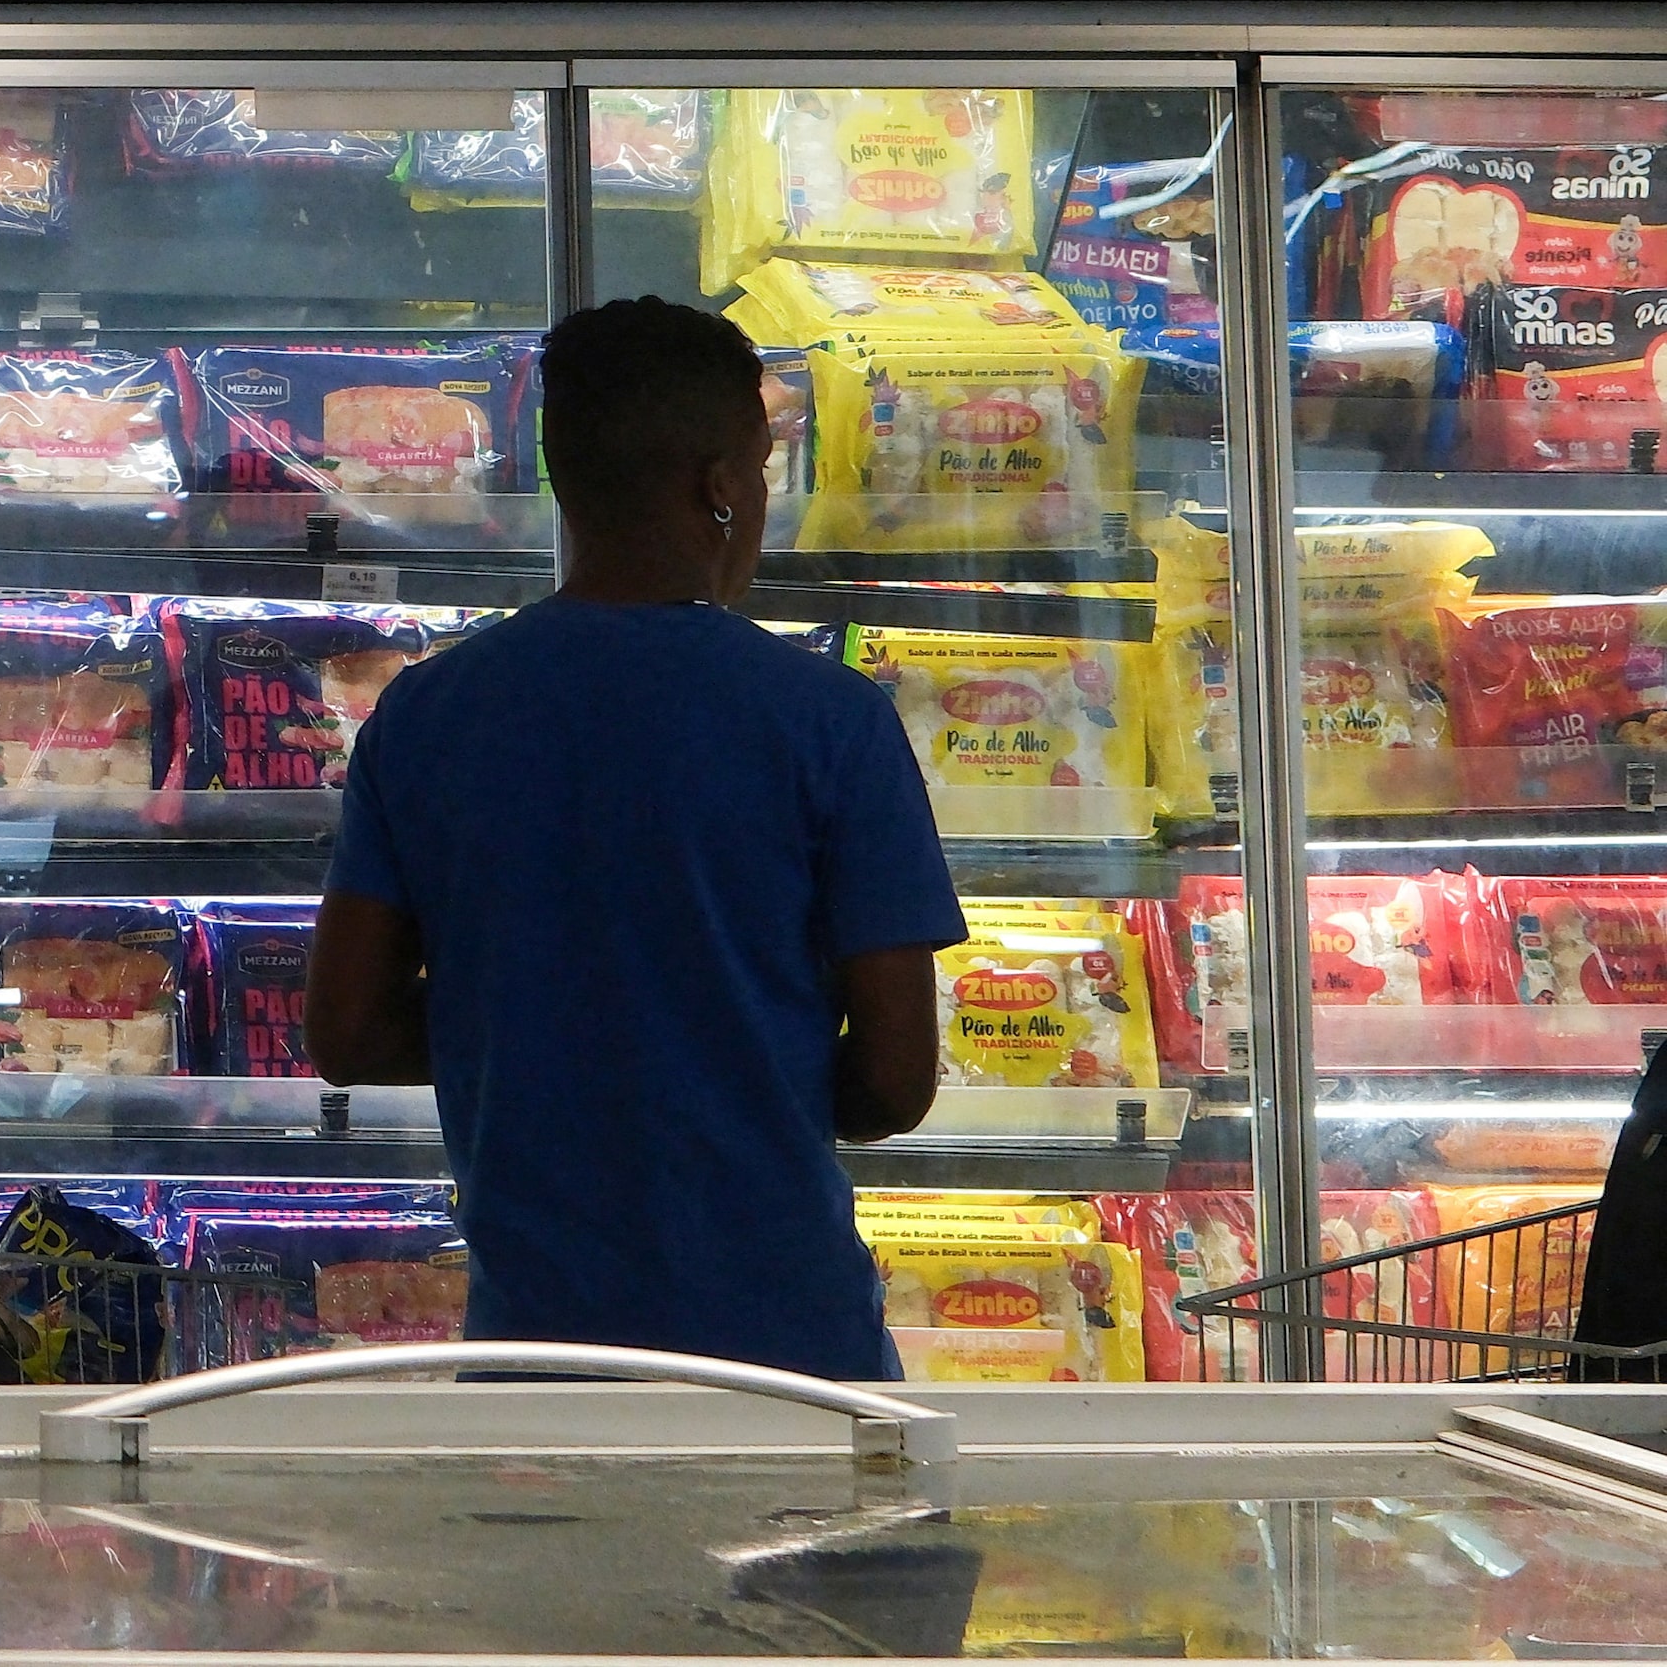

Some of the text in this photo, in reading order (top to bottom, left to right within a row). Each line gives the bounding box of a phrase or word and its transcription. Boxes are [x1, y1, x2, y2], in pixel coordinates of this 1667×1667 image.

[1514, 289, 1557, 321] Só
[1514, 320, 1615, 346] minas
[907, 369, 931, 377] Sabor
[933, 369, 946, 377] de
[948, 368, 973, 377] Brasil
[989, 368, 1011, 377] cada
[226, 384, 284, 396] MEZZANI
[227, 410, 292, 452] PÃO
[944, 407, 1039, 435] Zinho
[229, 452, 272, 486] DE
[938, 448, 1043, 471] Pão de Alho
[948, 472, 1032, 483] TRADICIONAL
[1313, 540, 1339, 557] Pão
[1342, 539, 1358, 554] de
[223, 645, 279, 658] MEZZANI
[949, 649, 975, 657] Brasil
[222, 673, 291, 715] PÃO
[949, 688, 1043, 718] Zinho
[224, 715, 268, 751] DE
[1545, 712, 1586, 740] AIR
[947, 730, 1050, 752] Pão de Alho
[224, 751, 316, 789] ALHO
[956, 754, 1041, 765] TRADICIONAL
[244, 954, 302, 966] MEZZANI
[960, 977, 1054, 1002] Zinho
[960, 1015, 1065, 1037] Pão de Alho
[246, 1025, 289, 1061] DE
[972, 1037, 1059, 1049] TRADICIONAL
[882, 1211, 894, 1219] de
[914, 1231, 939, 1239] Brasil
[957, 1231, 978, 1240] cada
[898, 1248, 926, 1256] Sabor
[941, 1249, 967, 1257] Brasil
[942, 1291, 1039, 1317] Zinho
